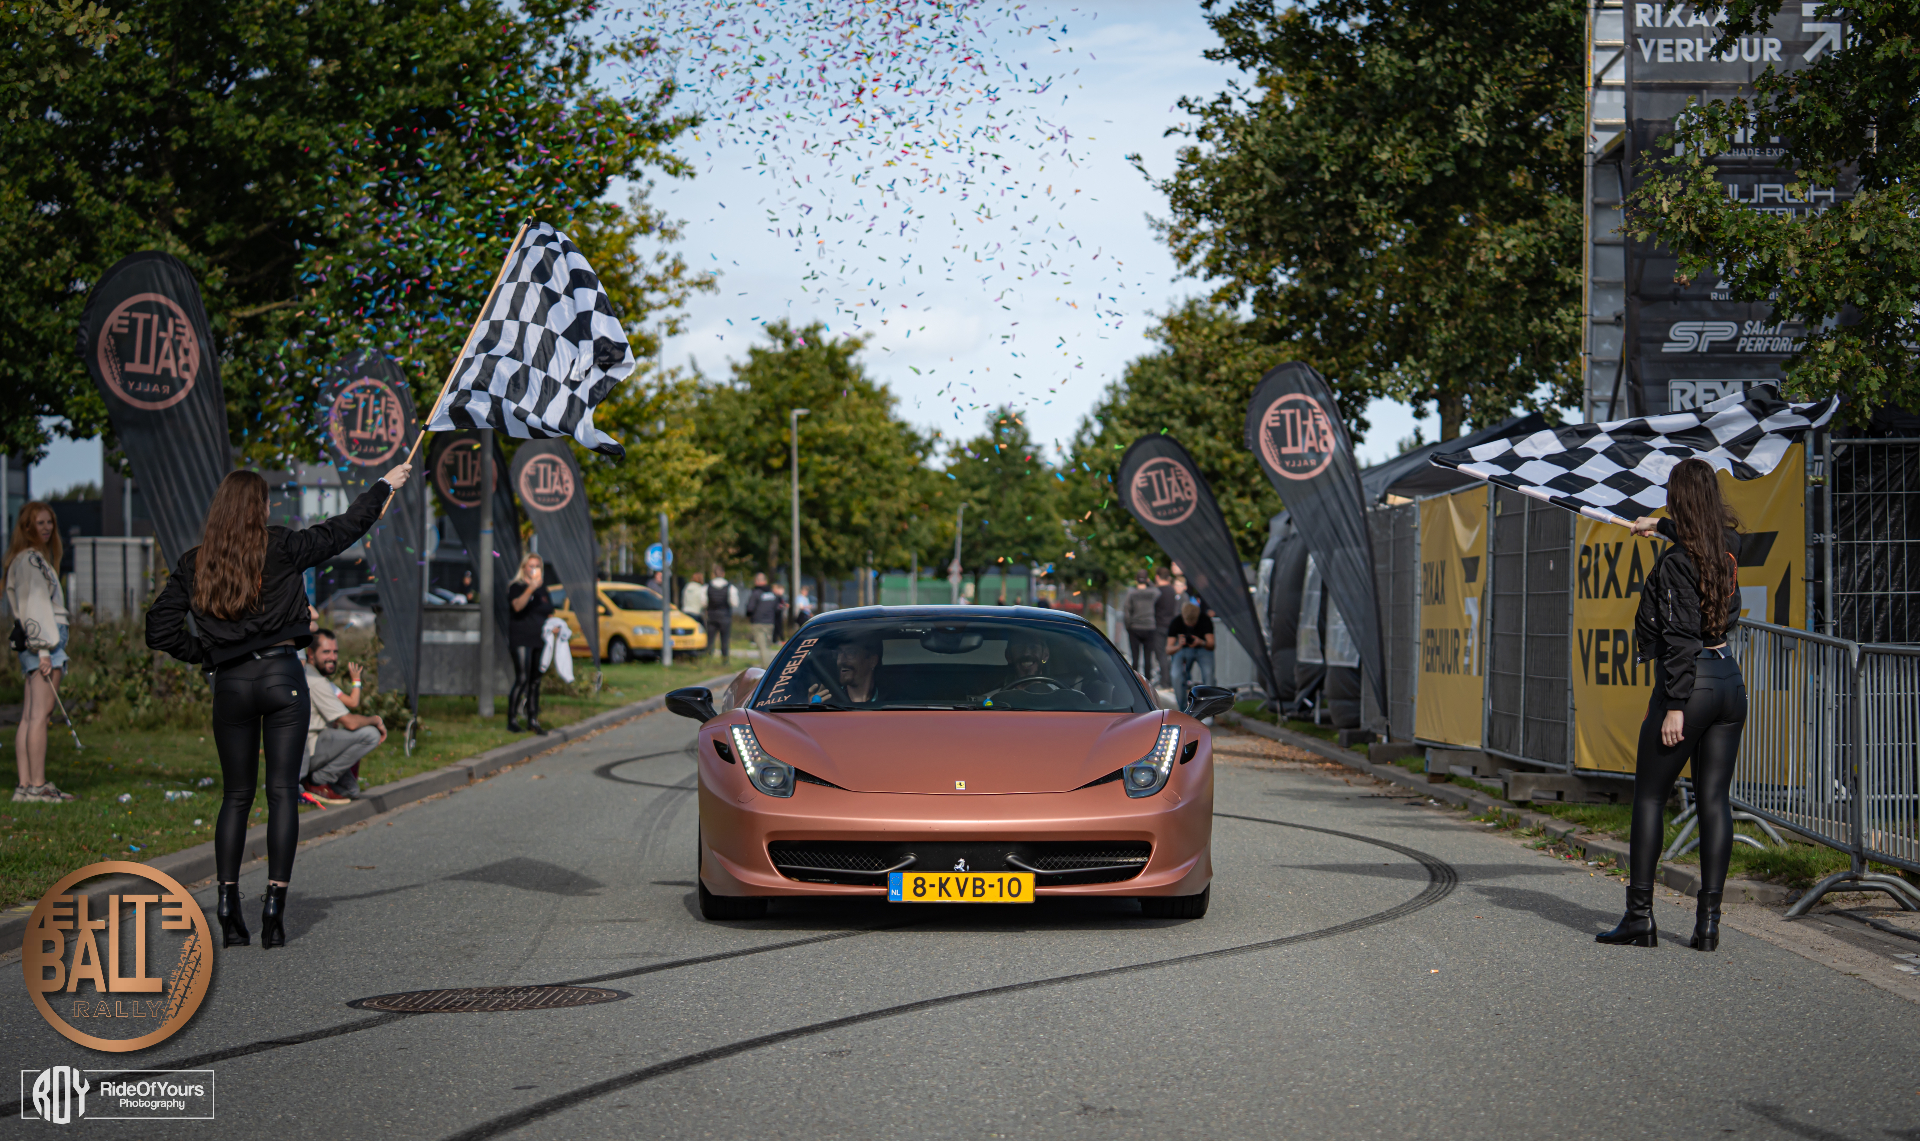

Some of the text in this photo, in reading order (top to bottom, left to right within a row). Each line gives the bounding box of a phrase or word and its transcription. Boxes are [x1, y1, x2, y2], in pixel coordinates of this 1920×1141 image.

[1661, 321, 1738, 352] SP
[756, 694, 792, 708] RALLY
[913, 876, 1022, 898] 8-KVB-10
